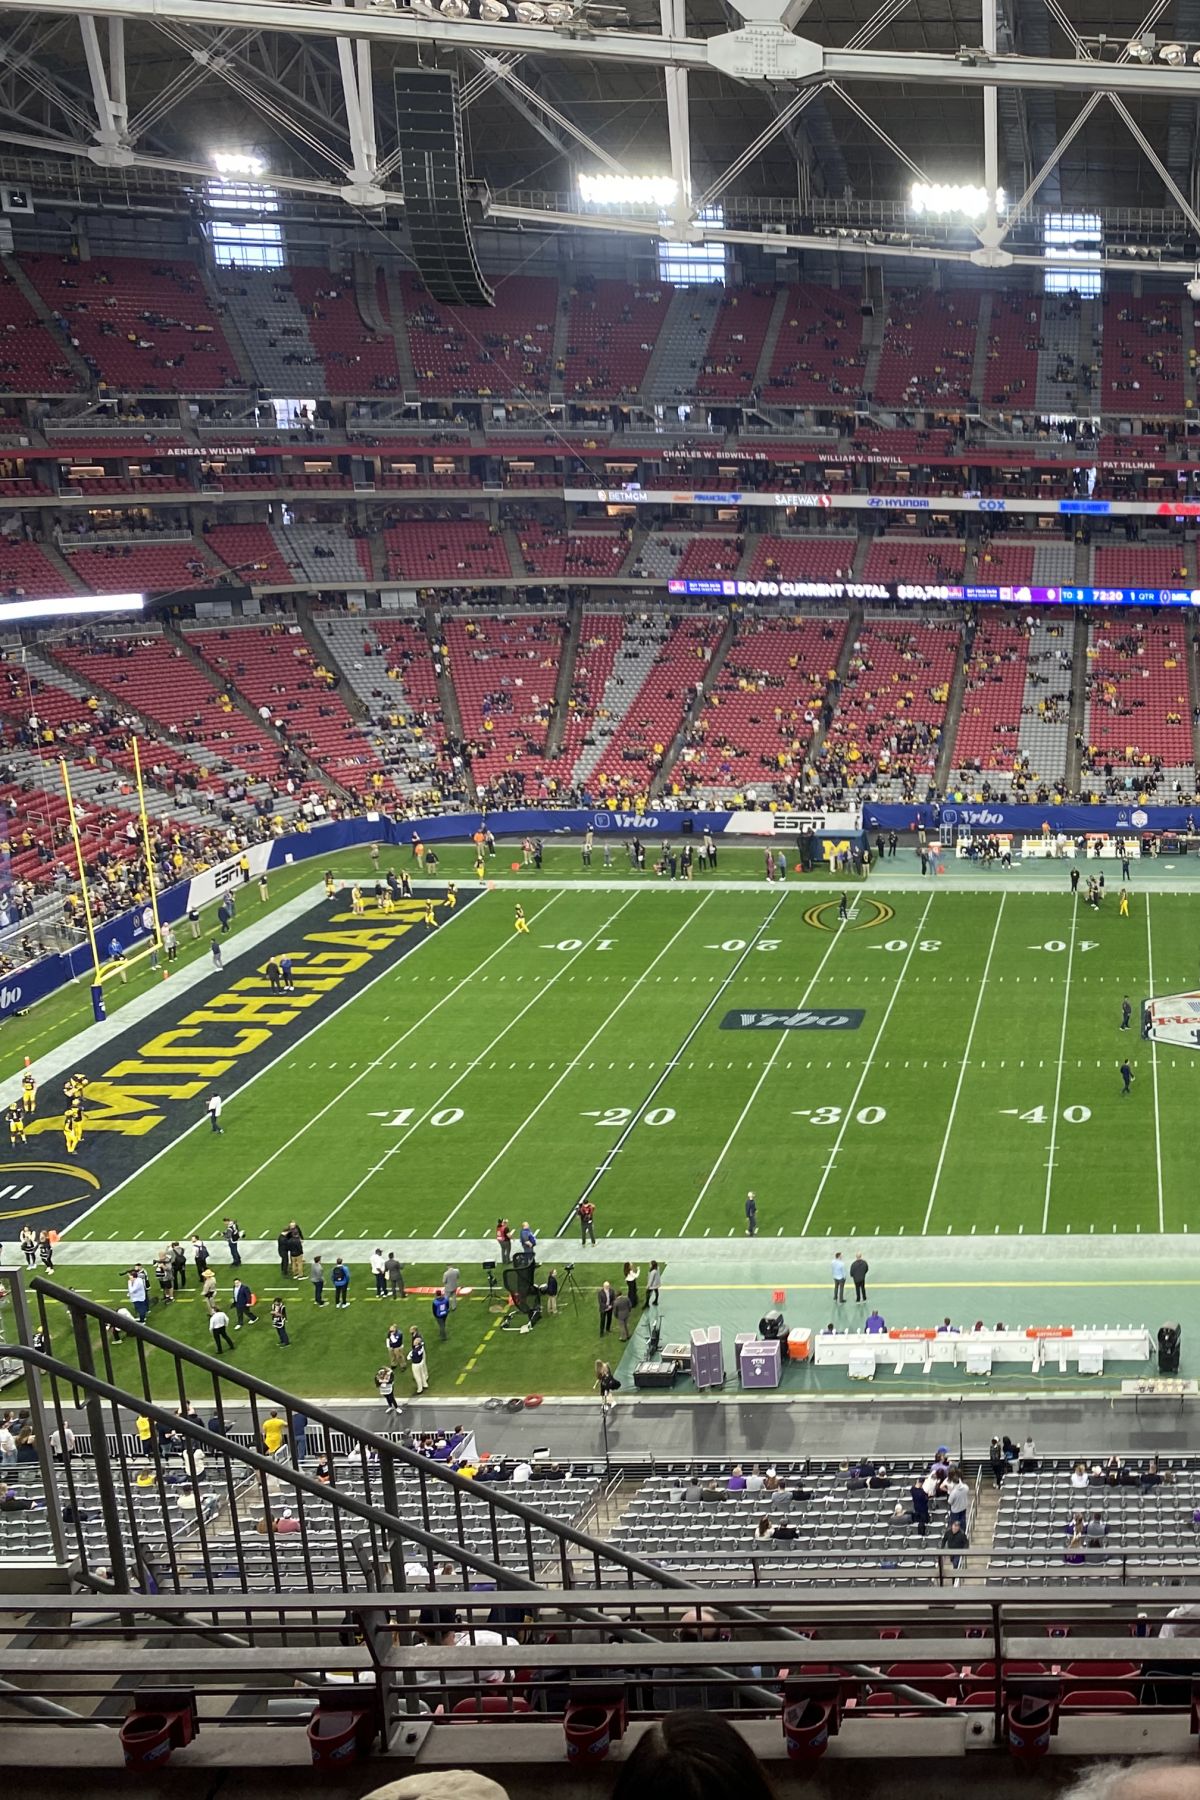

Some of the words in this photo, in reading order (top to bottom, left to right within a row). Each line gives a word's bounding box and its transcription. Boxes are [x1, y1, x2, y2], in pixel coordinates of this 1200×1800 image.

[819, 454, 857, 462] WILLIAM
[608, 491, 647, 501] BETMGM
[775, 495, 818, 505] SAFEWAY
[885, 500, 930, 508] HYUNDAI
[978, 501, 1006, 510] COX
[738, 581, 779, 597] 50/50
[780, 582, 844, 597] CURRENT
[845, 583, 890, 598] TOTAL
[1093, 590, 1123, 602] 72:20
[1138, 592, 1155, 601] QTR
[614, 813, 659, 828] Vrbo
[774, 816, 826, 829] ESPN
[960, 809, 1004, 824] Vrbo
[822, 840, 851, 860] M
[215, 861, 244, 888] ESPN
[556, 939, 619, 951] 10
[721, 939, 783, 952] 20
[884, 940, 943, 952] 30
[1044, 940, 1100, 953] 40
[25, 898, 445, 1137] MICHIGAN
[740, 1012, 850, 1026] Vrbo
[380, 1107, 465, 1126] 10
[594, 1107, 677, 1126] 20
[808, 1106, 888, 1126] 30
[1018, 1105, 1092, 1125] 40
